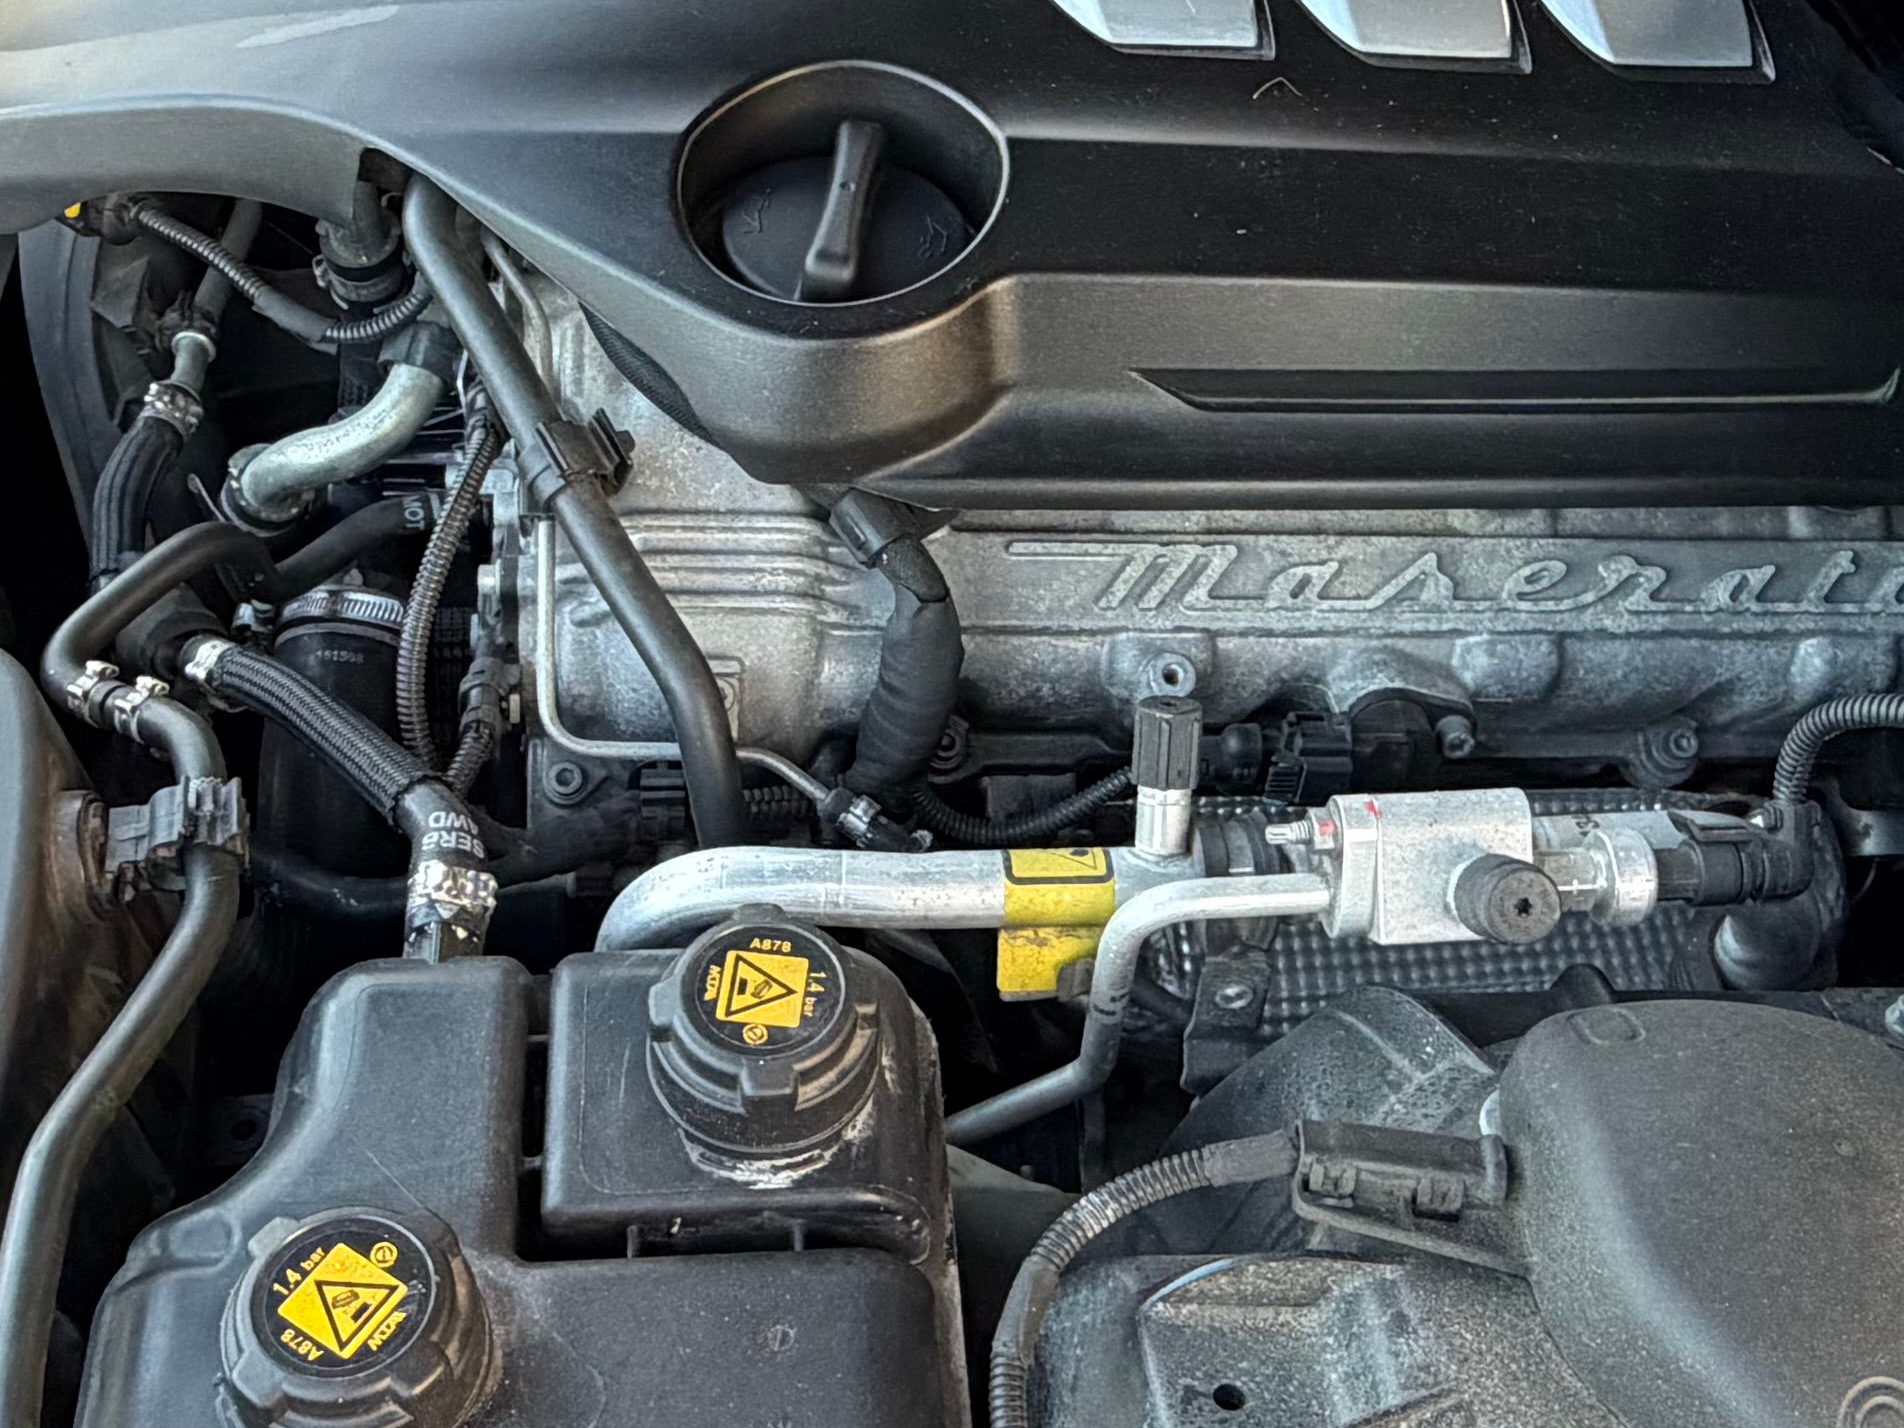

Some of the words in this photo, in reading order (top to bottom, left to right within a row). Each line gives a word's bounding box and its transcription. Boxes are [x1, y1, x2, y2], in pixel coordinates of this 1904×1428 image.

[749, 937, 792, 953] A878
[807, 971, 827, 993] 1.4
[803, 996, 818, 1017] bar
[272, 1267, 302, 1296] 1.4
[300, 1246, 326, 1272] bar
[280, 1328, 325, 1361] A878
